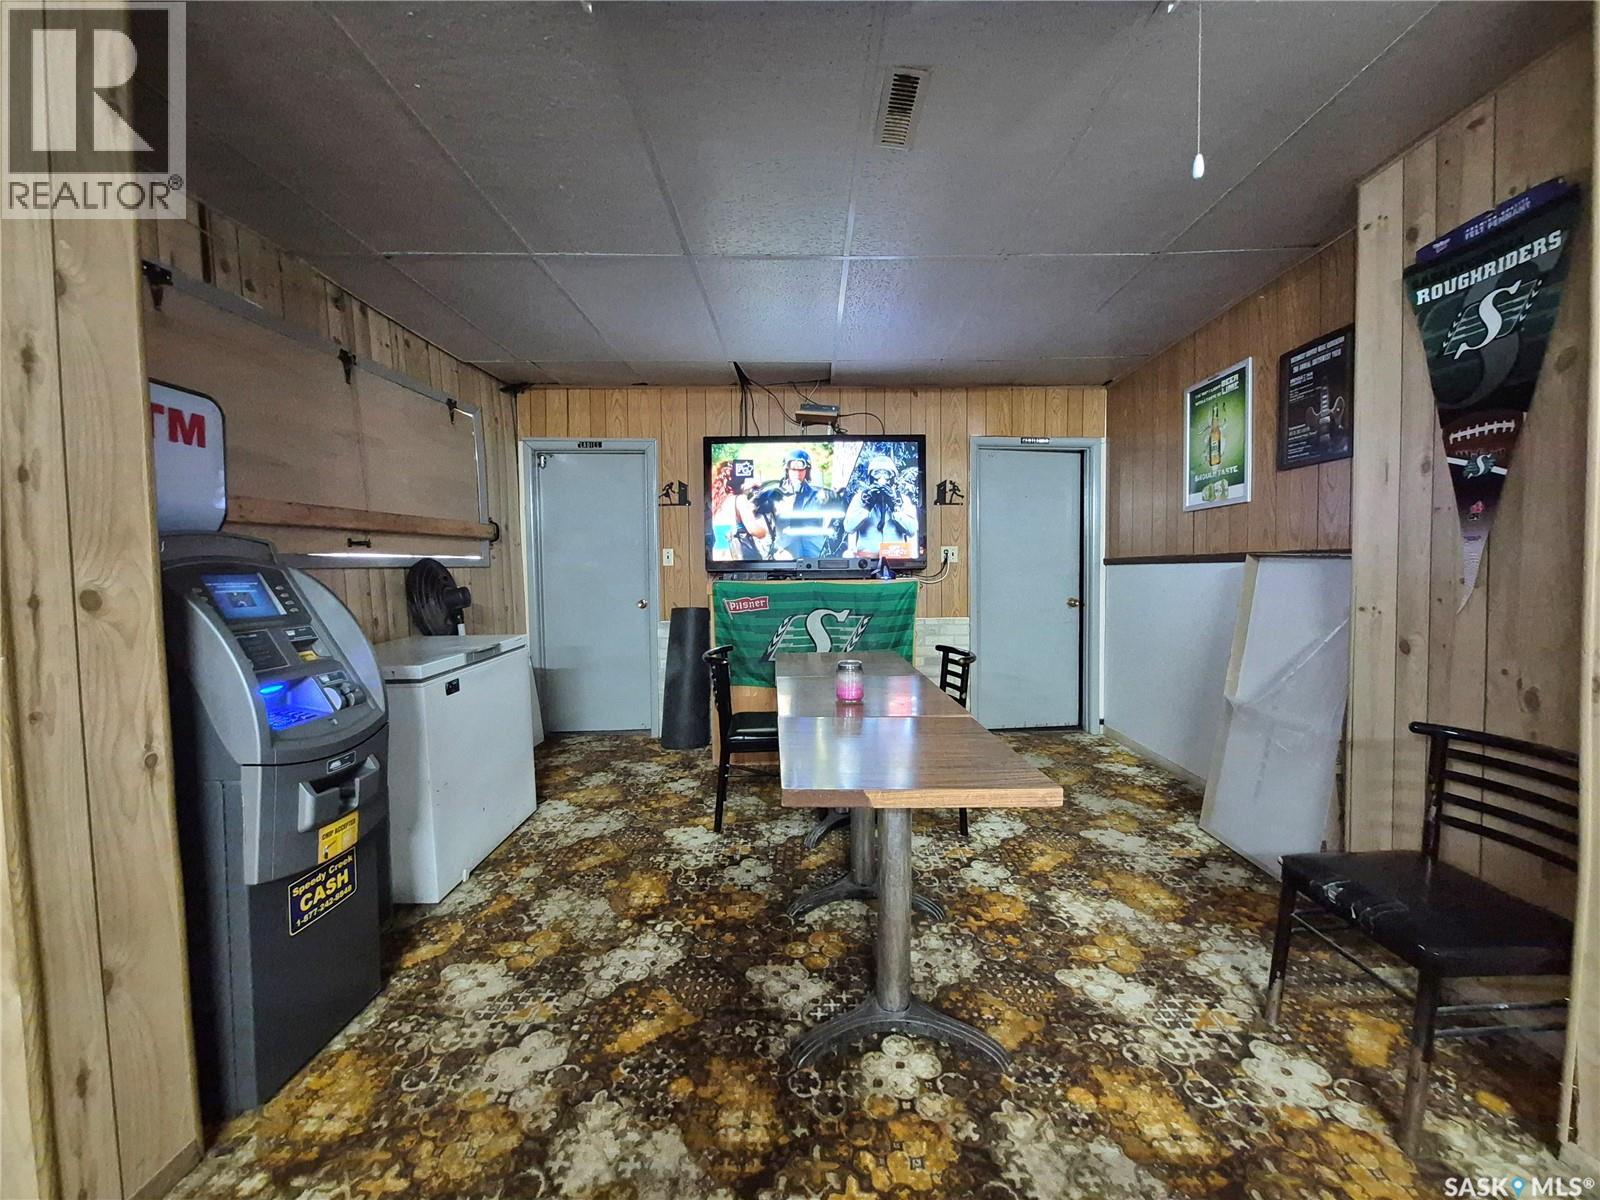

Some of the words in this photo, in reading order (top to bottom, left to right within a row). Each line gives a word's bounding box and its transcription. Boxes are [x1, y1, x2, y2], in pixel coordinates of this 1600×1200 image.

[1464, 222, 1486, 241] FELT
[1487, 200, 1532, 230] PENNANT
[1416, 230, 1562, 305] ROUGHRIDERS
[1218, 465, 1239, 477] TASTE
[730, 600, 766, 611] Pilsner
[292, 871, 326, 898] Speedy
[328, 855, 353, 875] Creek
[300, 868, 349, 912] CASH
